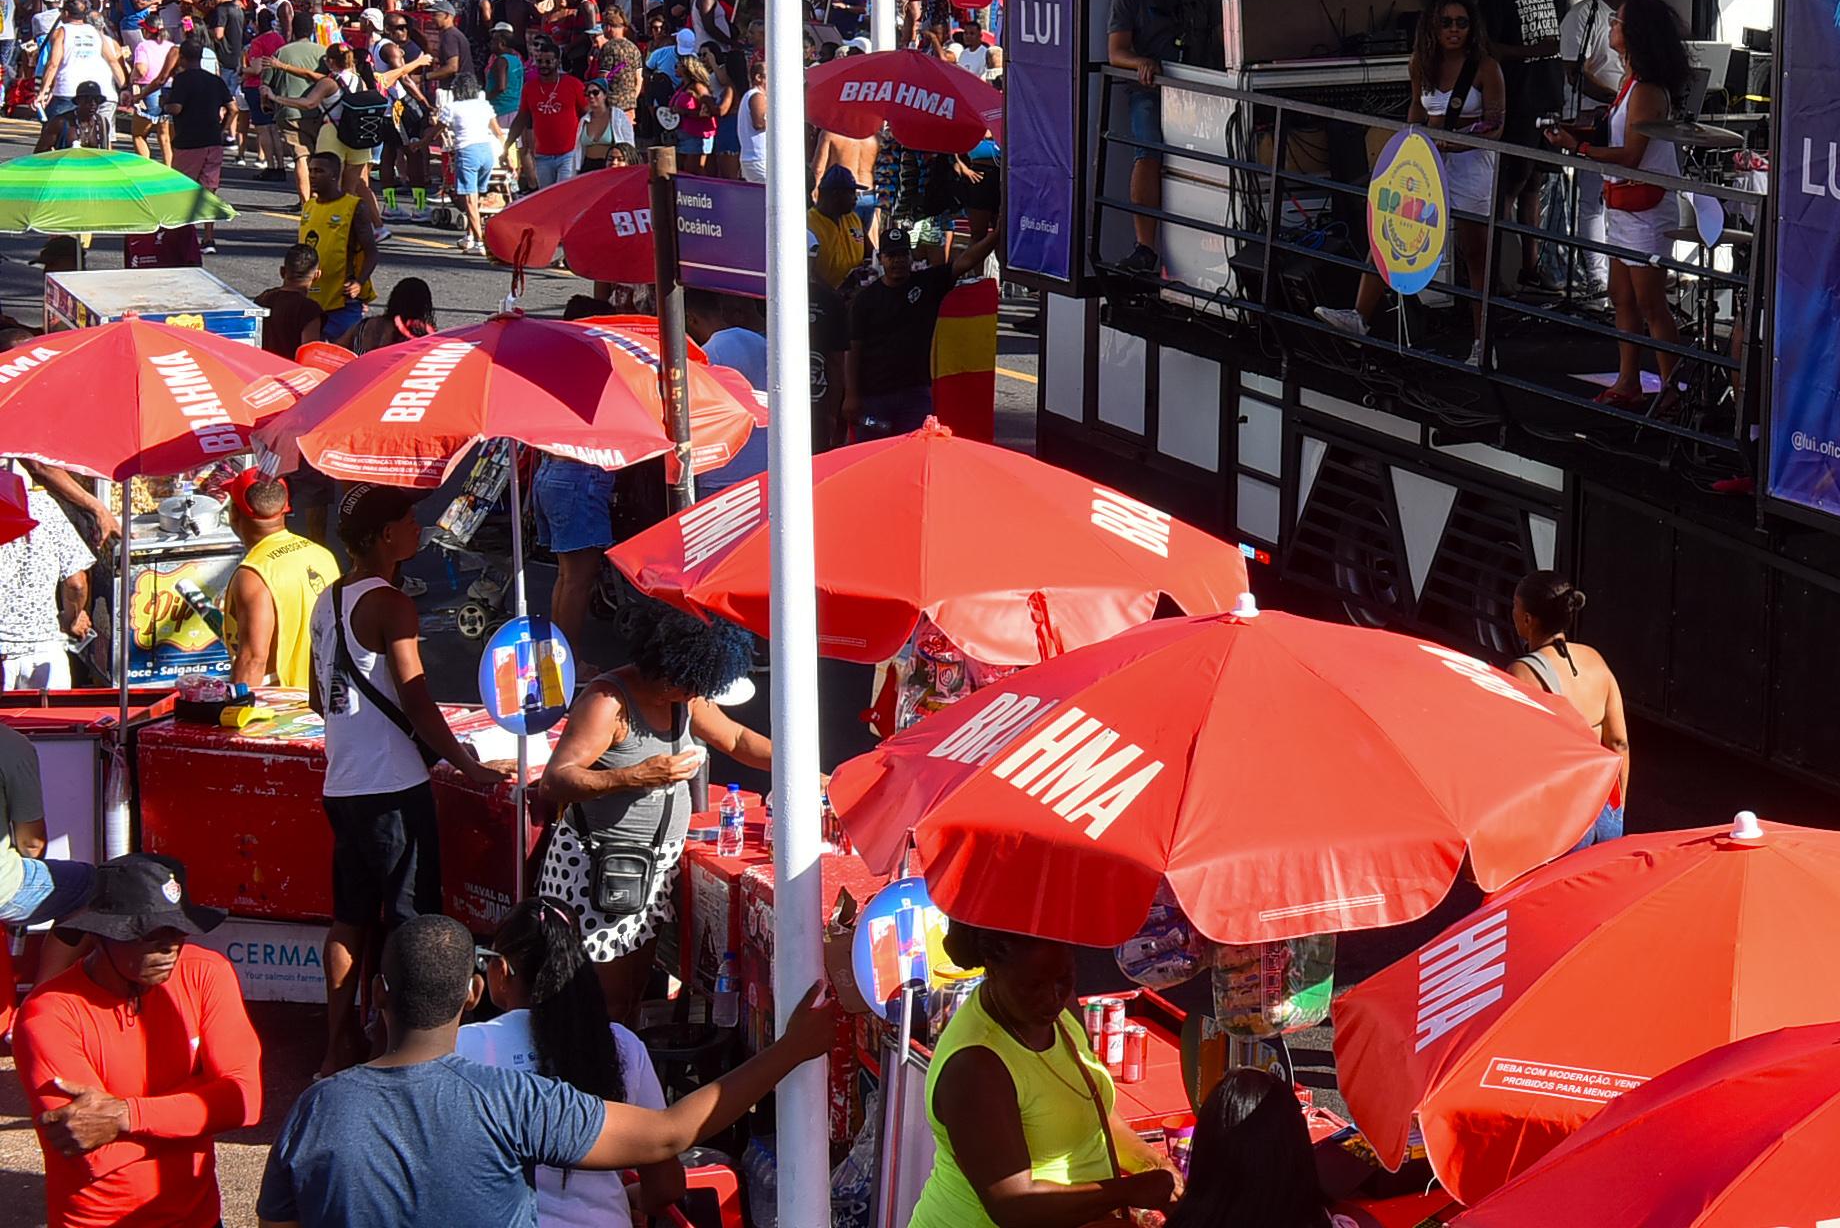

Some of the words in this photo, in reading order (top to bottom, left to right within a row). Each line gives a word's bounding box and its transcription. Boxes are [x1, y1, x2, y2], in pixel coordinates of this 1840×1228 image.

[1020, 0, 1061, 46] LUI
[840, 81, 956, 119] BRAHMA
[677, 191, 712, 209] Avenida
[677, 216, 722, 237] Oceânica
[380, 340, 482, 423] BRAHMA
[149, 349, 243, 454] BRAHMA
[160, 662, 206, 676] Salgada
[227, 943, 321, 967] CERMA
[265, 973, 295, 981] salmon
[1496, 1063, 1523, 1074] BEBA
[1524, 1067, 1547, 1077] COM
[1548, 1070, 1612, 1086] MODERAÇÃO.
[1502, 1076, 1555, 1090] PROIBIDOS
[1556, 1084, 1582, 1094] PARA
